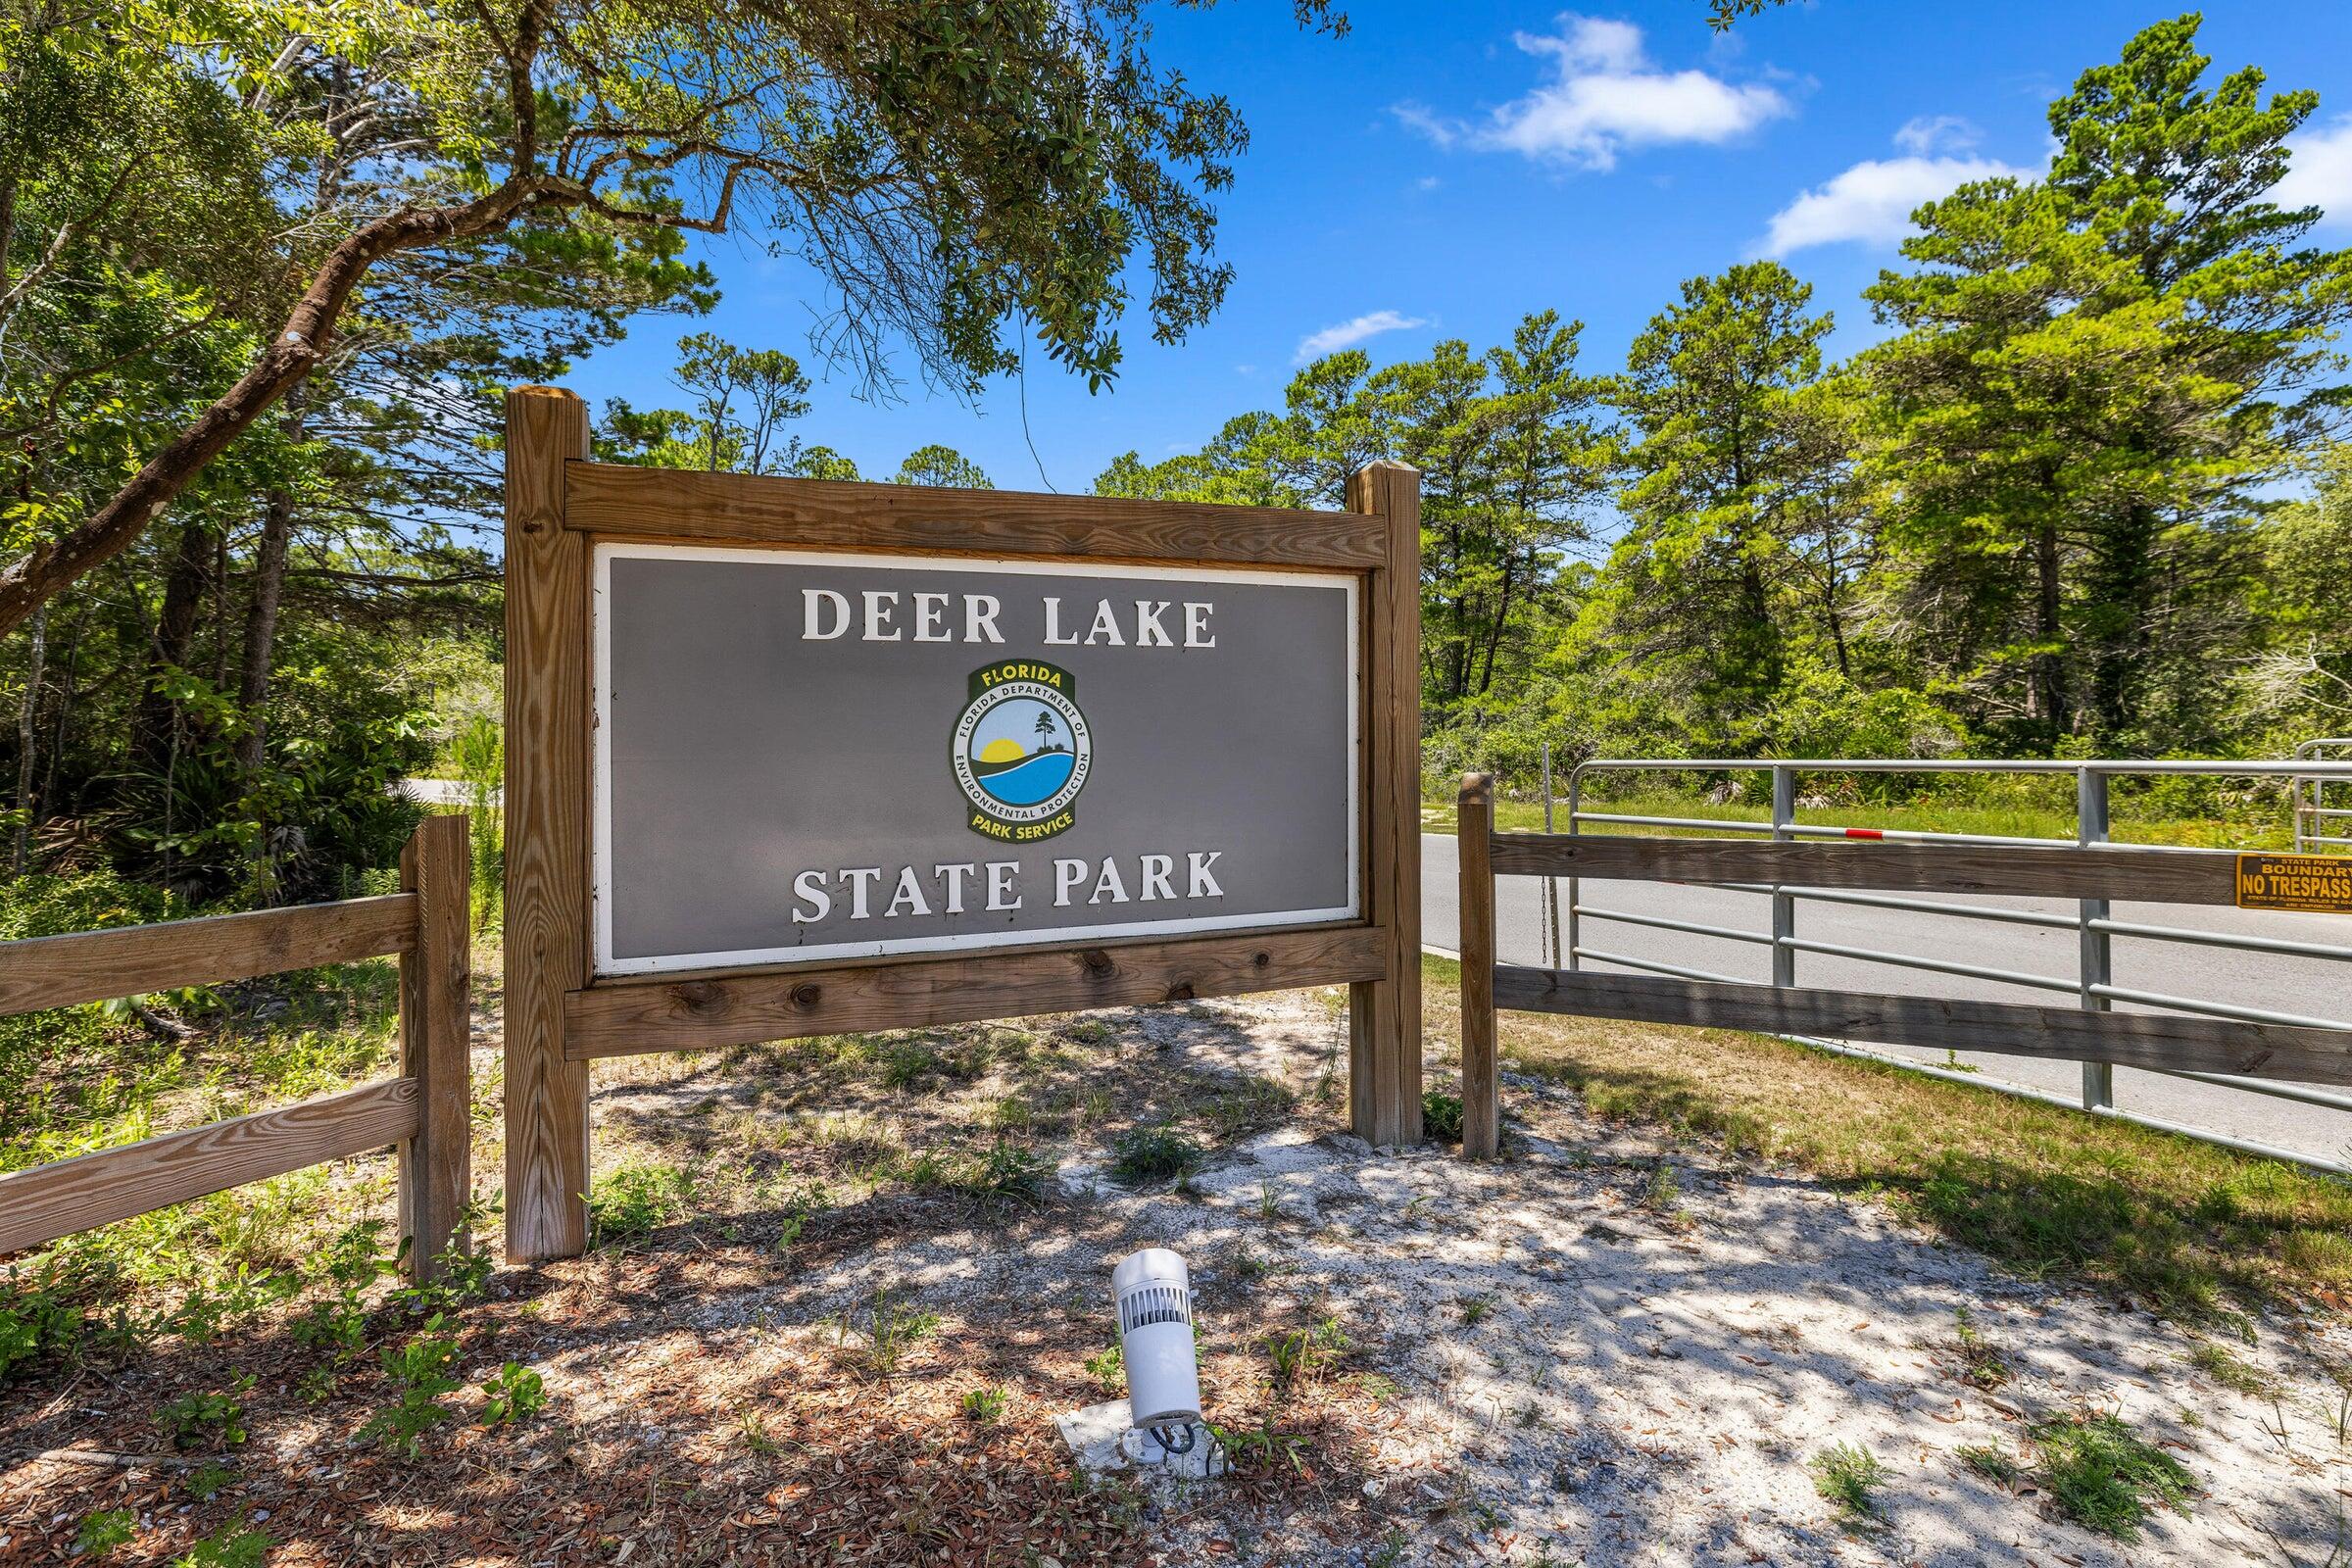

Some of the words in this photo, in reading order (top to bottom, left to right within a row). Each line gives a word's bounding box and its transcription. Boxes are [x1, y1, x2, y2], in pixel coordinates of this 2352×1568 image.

[802, 589, 1005, 643] DEER
[1044, 597, 1216, 648] LAKE
[981, 664, 1061, 687] FLORIDA
[959, 693, 998, 738] FLORIDA
[1002, 685, 1076, 718] DEPARTMENT
[1074, 722, 1086, 738] OF
[956, 755, 1035, 818] ENVIRONMENTAL
[1041, 753, 1088, 814] PROTECTION
[971, 814, 1012, 839] PARK
[1016, 812, 1073, 839] SERVICE
[792, 861, 1022, 922] STATE
[1054, 852, 1223, 907] PARK
[2242, 874, 2265, 895] NO
[2269, 875, 2351, 899] TRESPASS
